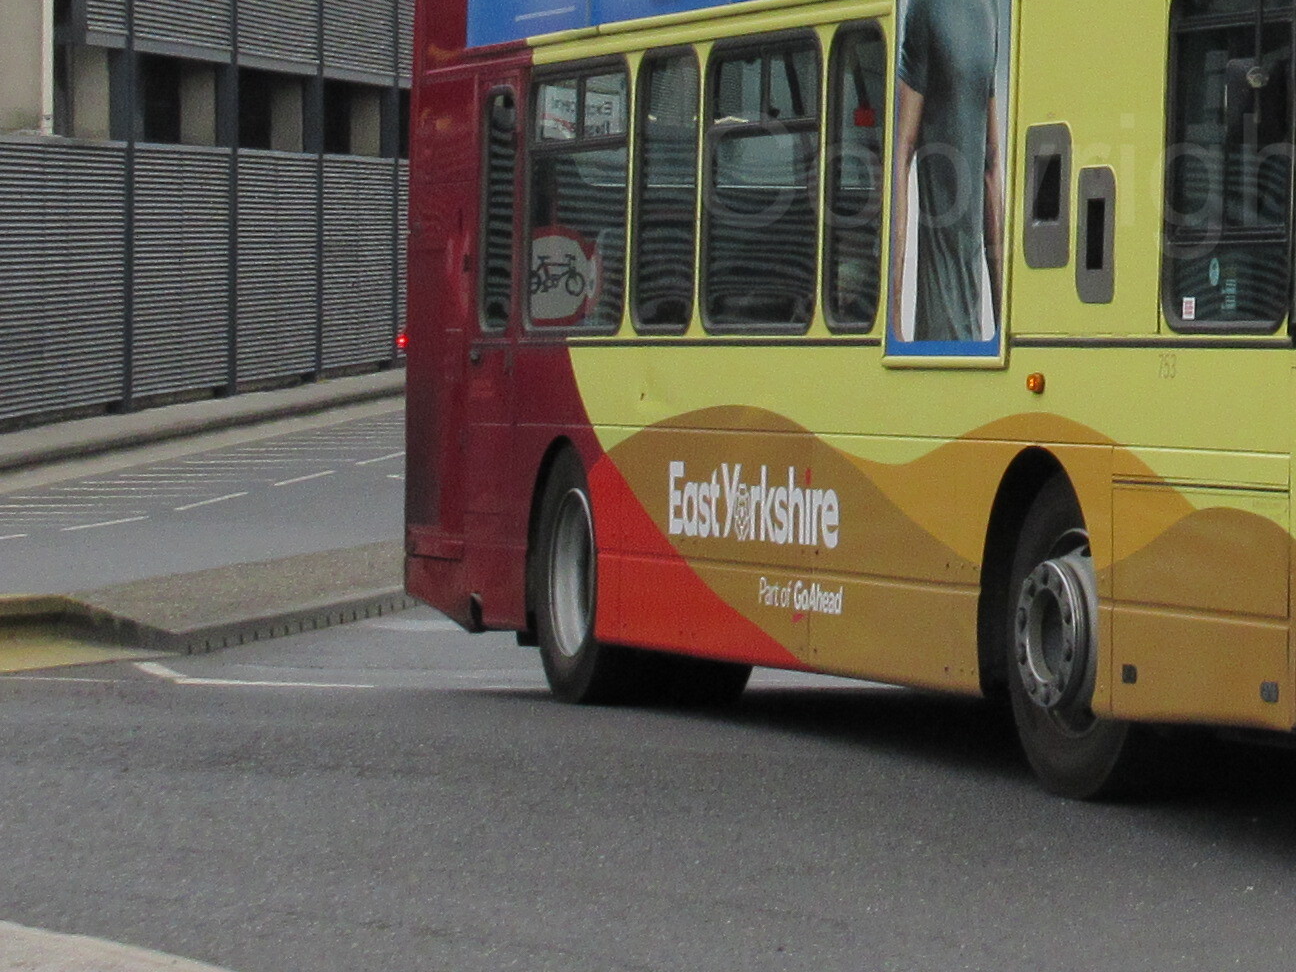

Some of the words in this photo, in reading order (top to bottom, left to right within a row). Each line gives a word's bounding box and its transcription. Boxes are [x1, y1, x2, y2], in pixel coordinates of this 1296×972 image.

[669, 460, 721, 538] East
[758, 576, 780, 607] Part
[780, 580, 793, 608] of
[793, 580, 844, 616] GoAhead
